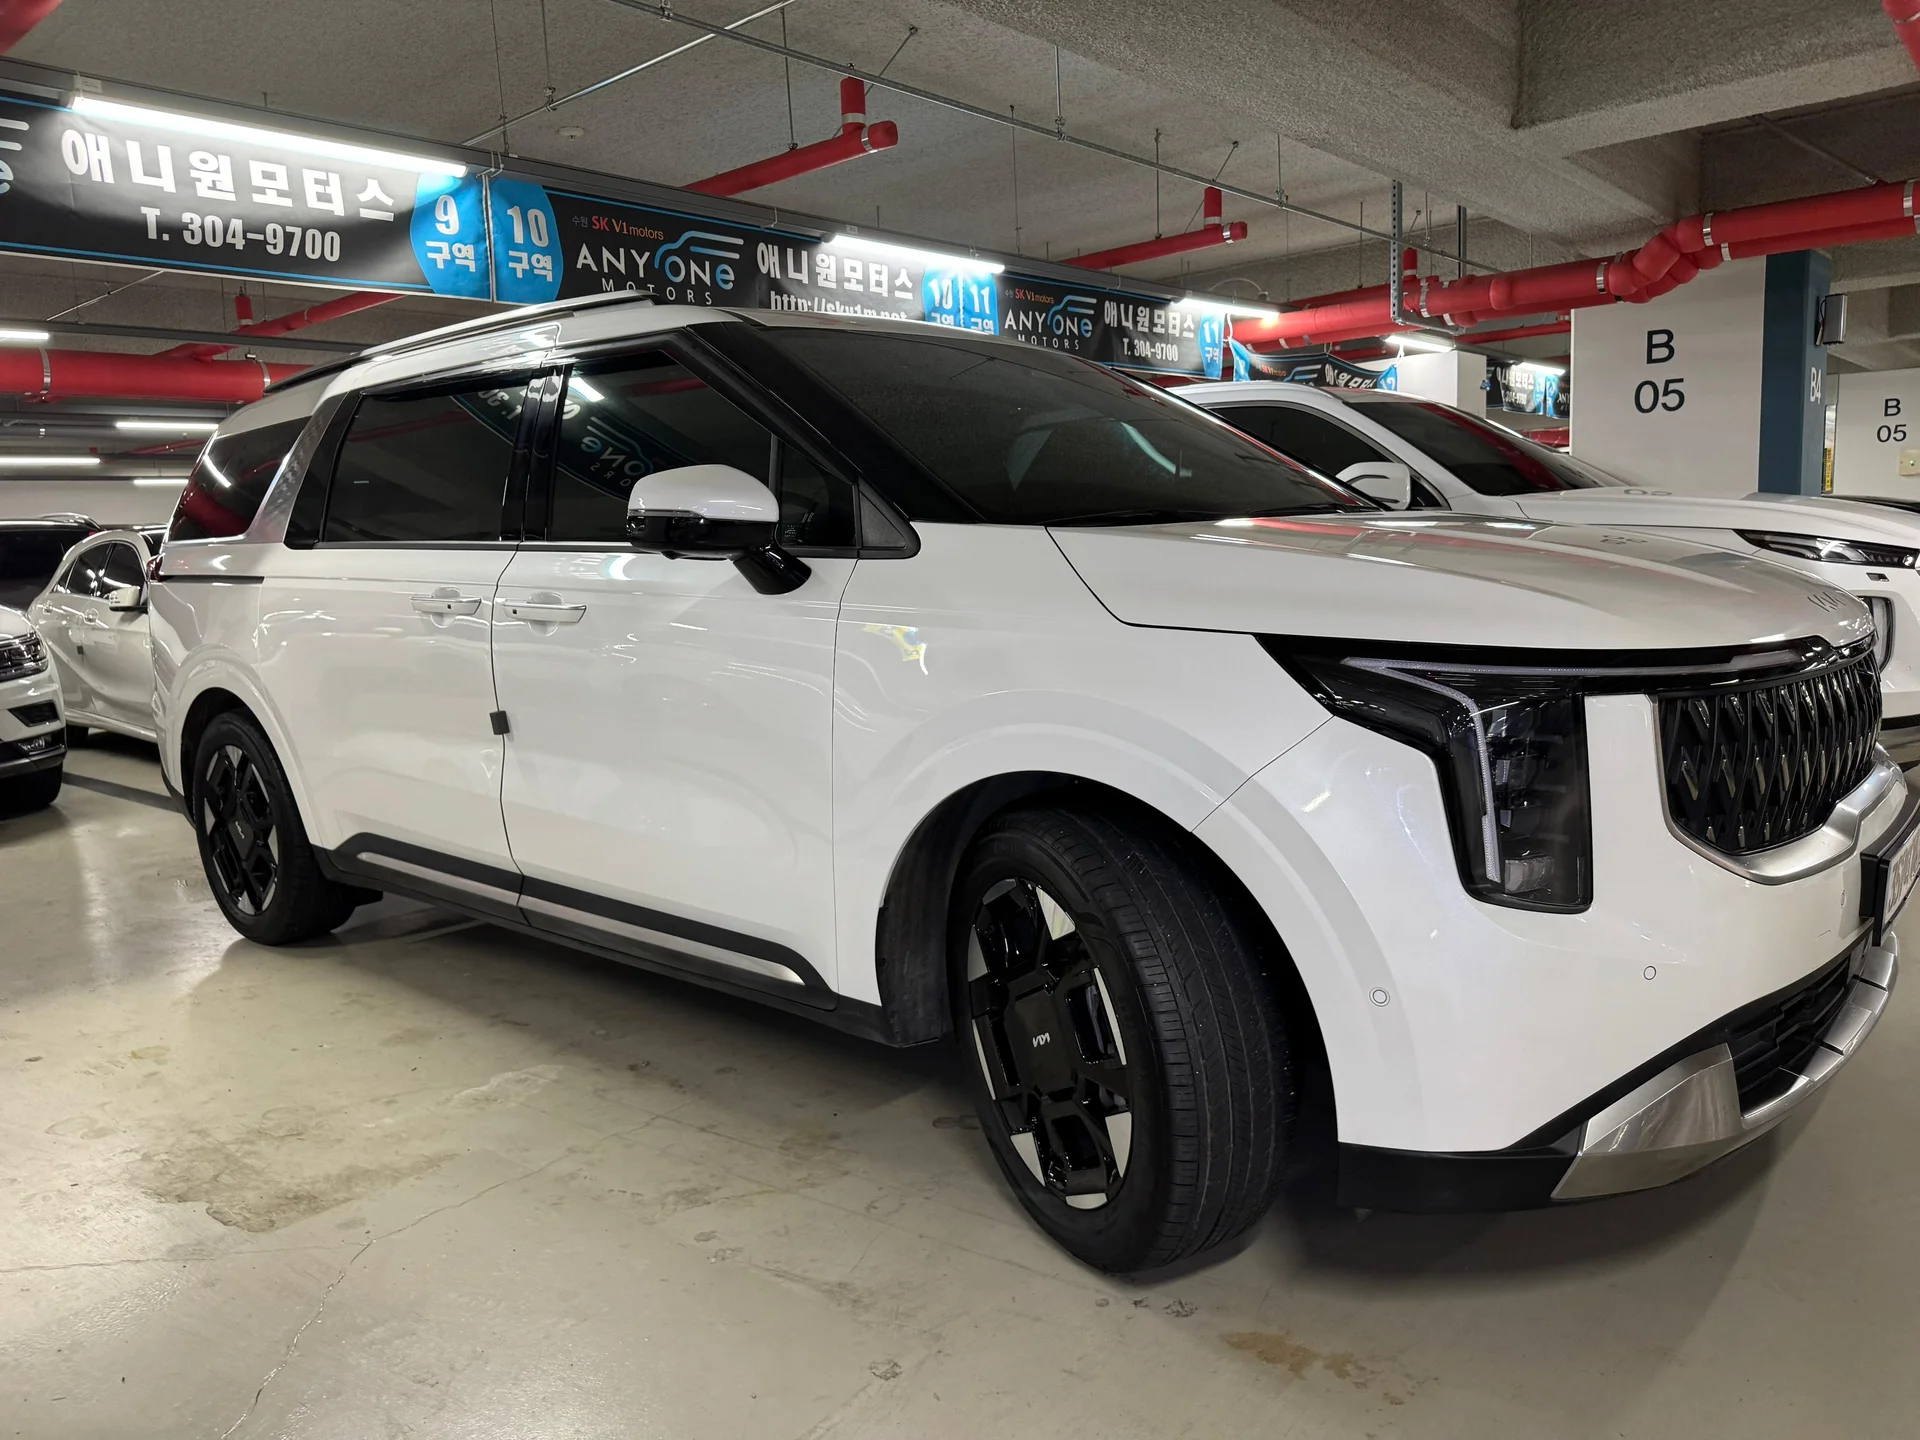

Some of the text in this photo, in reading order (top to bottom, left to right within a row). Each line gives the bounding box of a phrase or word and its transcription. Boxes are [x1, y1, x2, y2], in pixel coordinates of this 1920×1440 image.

[61, 129, 395, 222] 애니원모터스
[435, 194, 460, 235] 9
[507, 205, 549, 248] 10
[591, 215, 610, 232] SK
[140, 206, 341, 263] T. 304-9700
[425, 240, 476, 273] 구역
[508, 250, 553, 283] 구역
[757, 242, 914, 300] 애니원모터스
[602, 277, 712, 305] MOTORS
[928, 278, 953, 310] 10
[970, 284, 991, 315] 11
[1104, 300, 1195, 339] 애니원모터스
[1203, 320, 1220, 344] 11
[1018, 333, 1080, 350] MOTORS
[1134, 338, 1179, 362] 304-9700
[1205, 346, 1220, 364] 구역
[1646, 329, 1675, 365] B
[1634, 378, 1685, 414] 05
[1810, 366, 1822, 405] B4
[1884, 398, 1902, 417] B
[1876, 424, 1907, 443] 05
